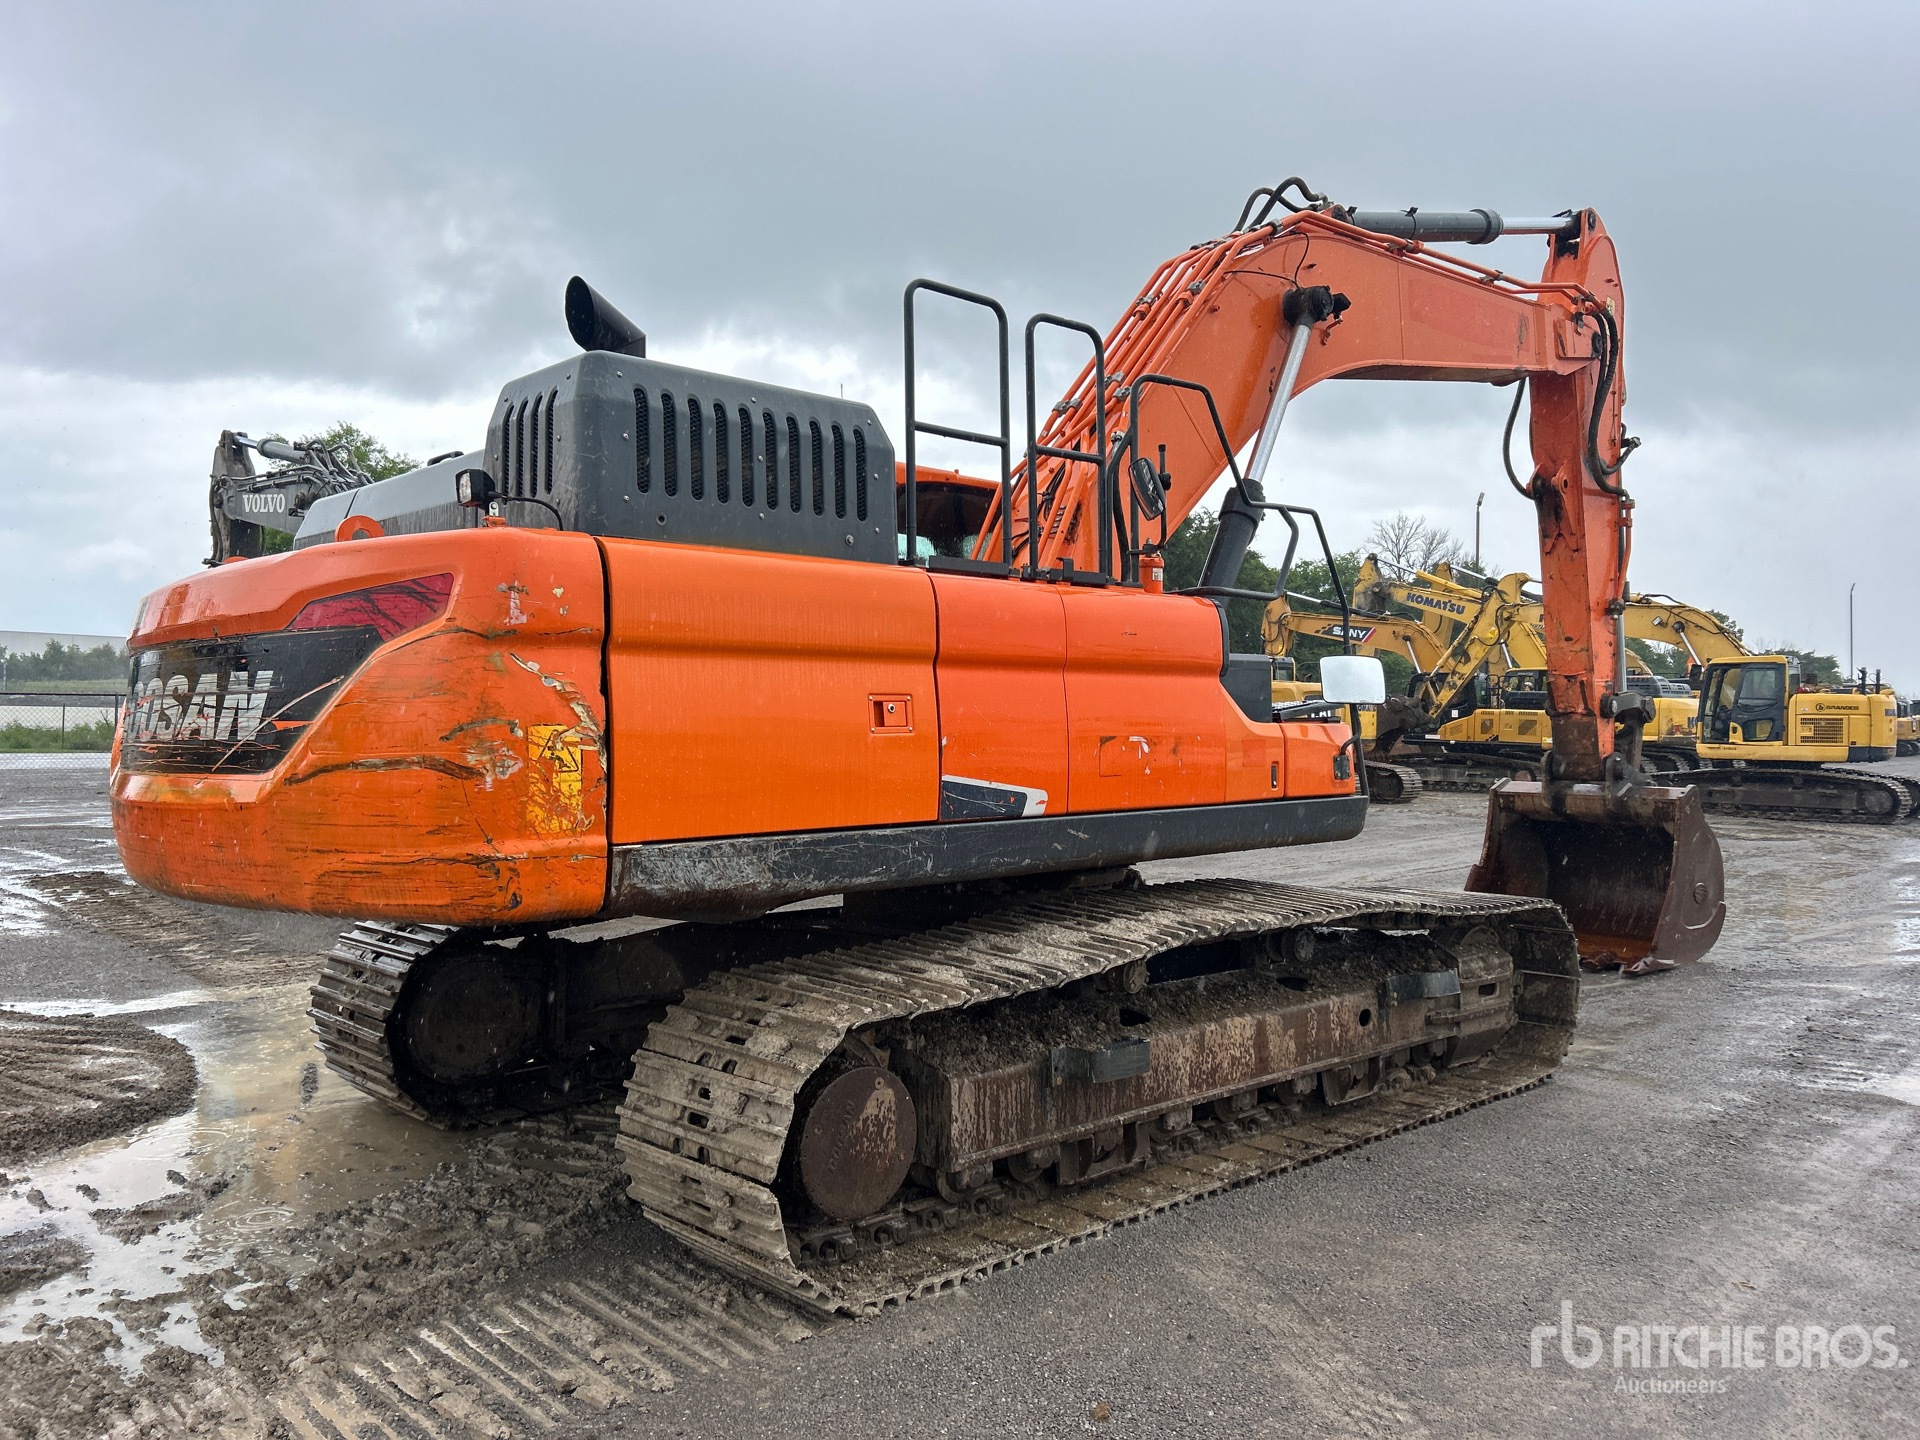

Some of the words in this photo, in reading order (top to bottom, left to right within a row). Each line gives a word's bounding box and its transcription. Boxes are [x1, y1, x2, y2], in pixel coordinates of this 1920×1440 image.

[243, 494, 286, 513] VOLVO
[1406, 592, 1466, 615] KOMATSU
[1332, 626, 1367, 639] SNY
